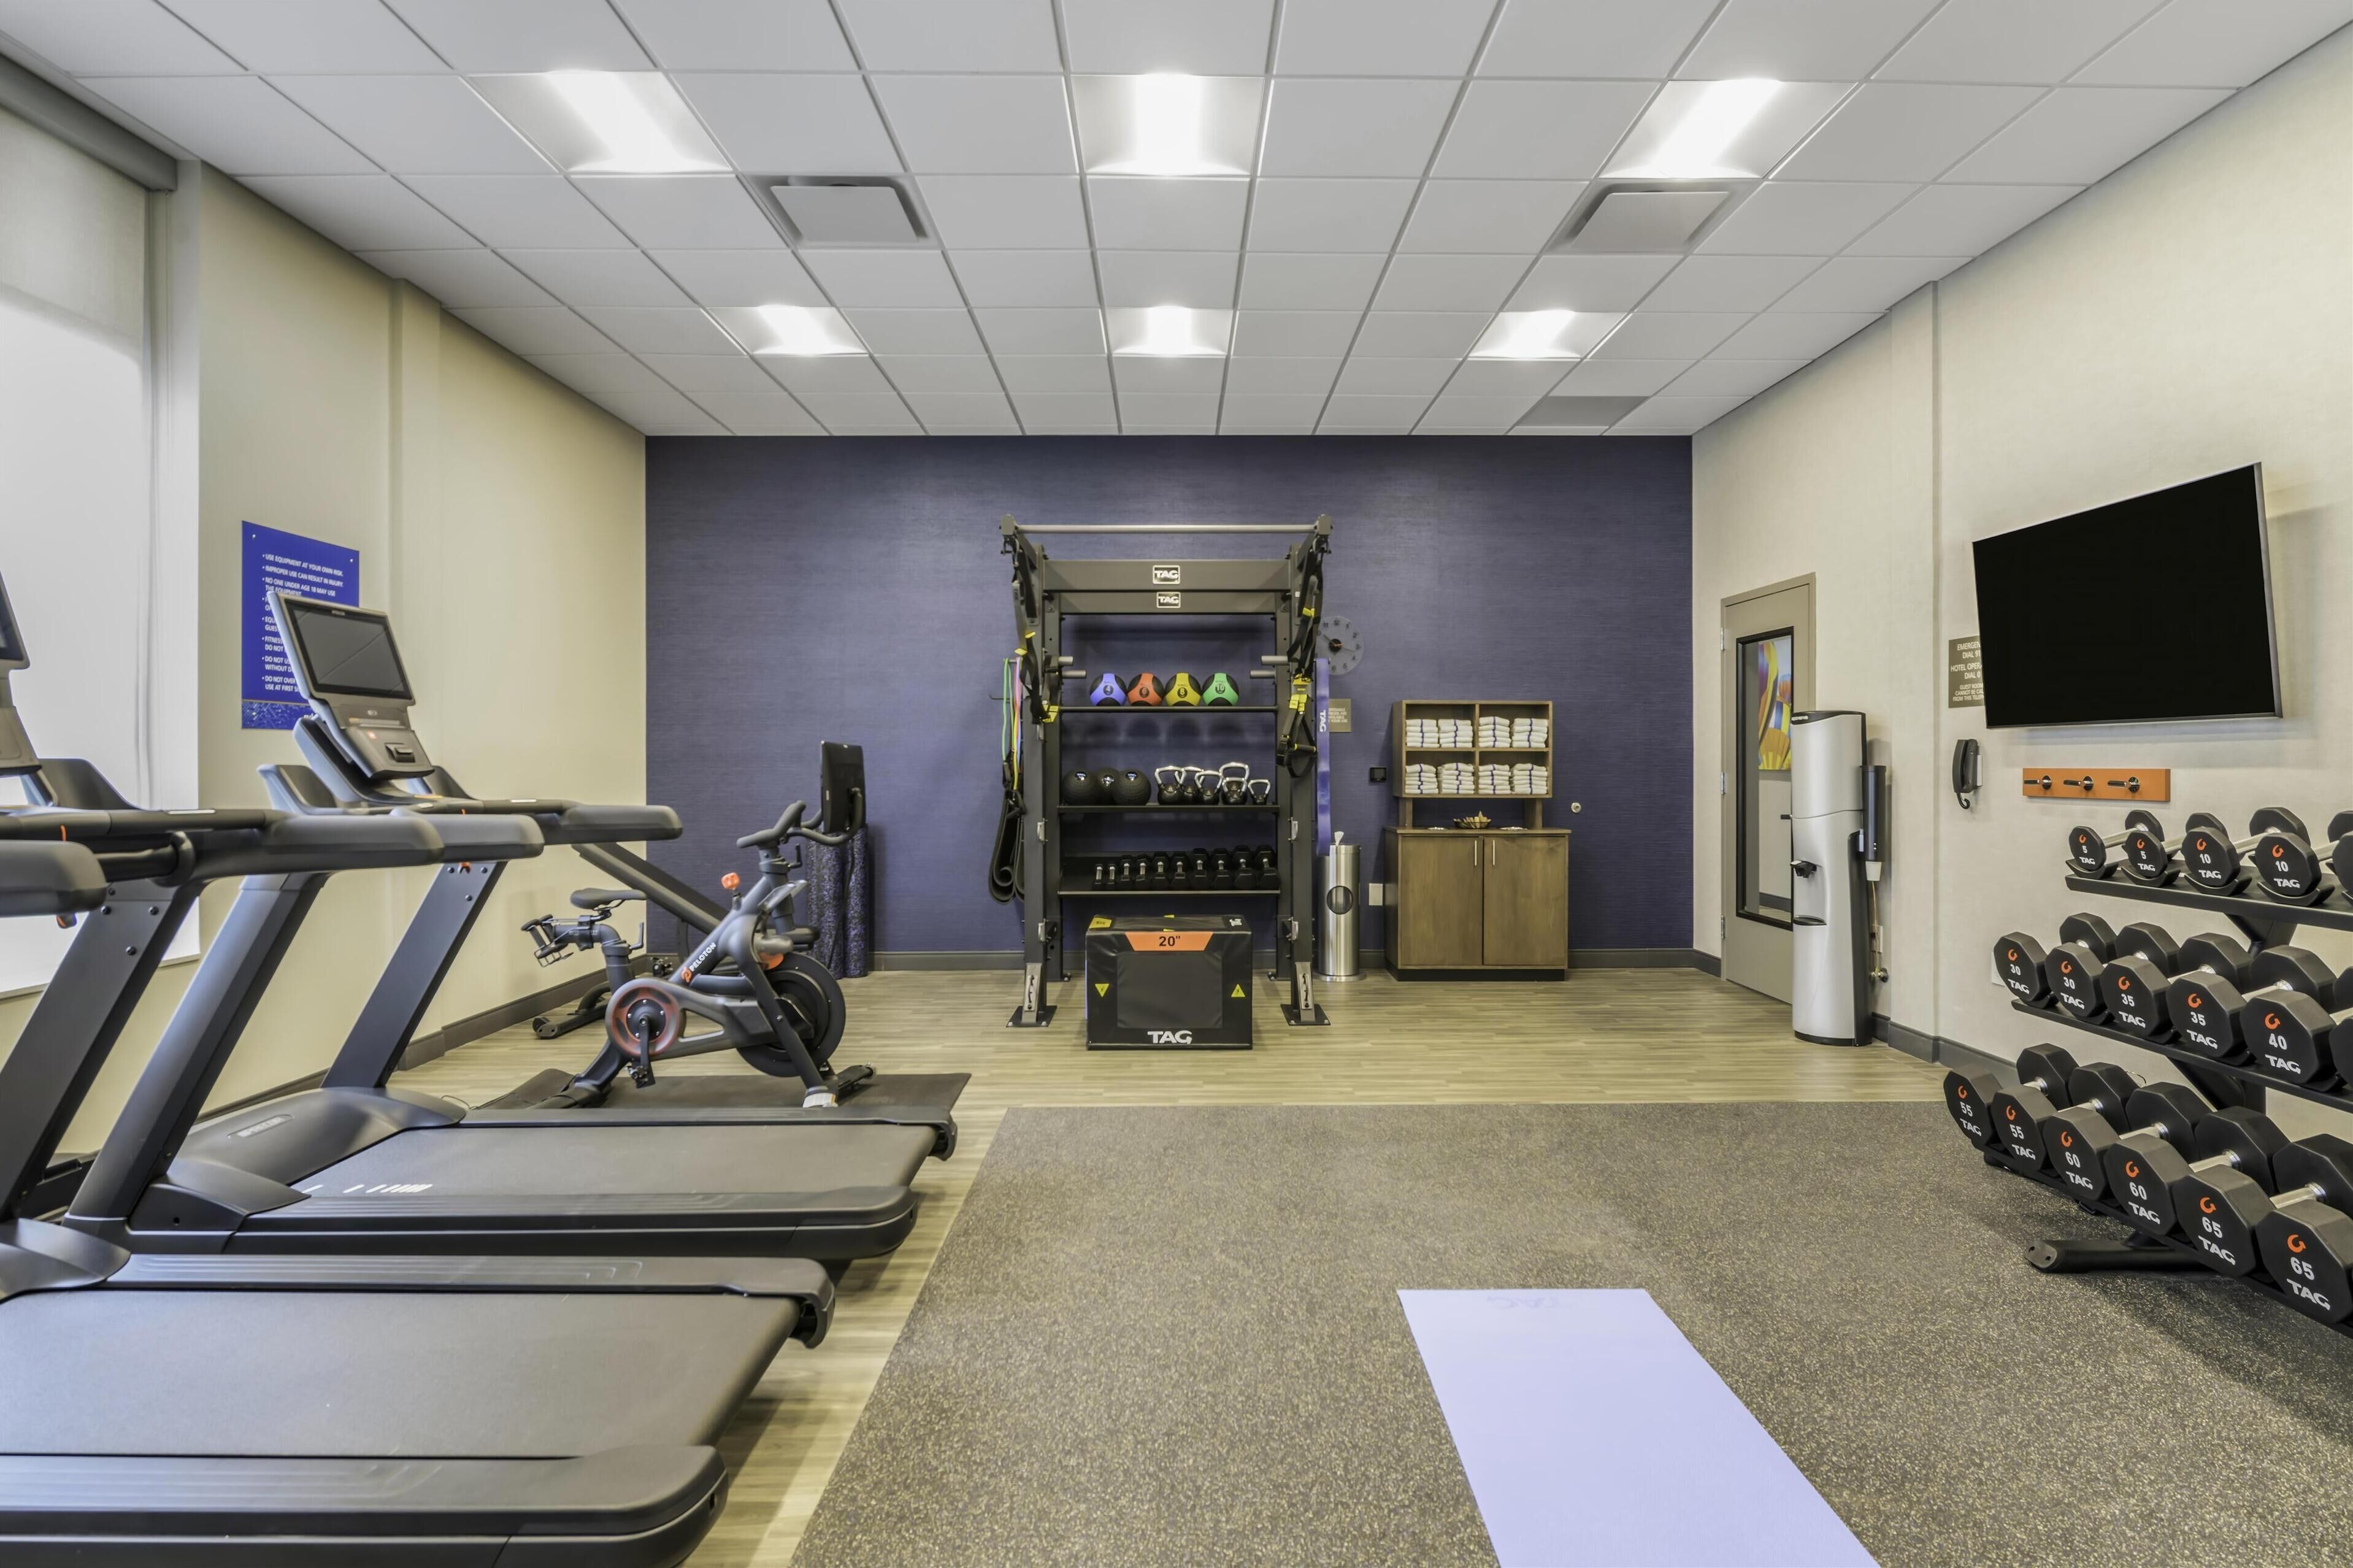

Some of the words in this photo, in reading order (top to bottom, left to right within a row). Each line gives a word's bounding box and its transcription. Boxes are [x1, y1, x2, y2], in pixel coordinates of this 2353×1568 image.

[275, 555, 302, 566] EQUIPMENT
[265, 565, 288, 575] IMPROPER
[308, 574, 323, 583] RESULT
[1154, 570, 1178, 579] TAG
[284, 580, 300, 590] UNDER
[1158, 596, 1179, 604] TAG
[1957, 641, 1981, 651] EMERGEN
[265, 664, 286, 672] WITHOUT
[1951, 664, 1965, 672] HOTEL
[2200, 853, 2211, 864] 10
[2276, 861, 2289, 872] 10
[2198, 870, 2221, 879] TAG
[2274, 878, 2300, 888] TAG
[1159, 936, 1180, 947] 20"
[689, 942, 716, 972] PELOTON
[2010, 964, 2021, 975] 30
[2008, 979, 2029, 994] TAG
[2063, 977, 2075, 990] 30
[2060, 993, 2084, 1010] TAG
[2122, 994, 2135, 1007] 35
[2119, 1011, 2145, 1028] TAG
[2190, 1012, 2206, 1026] 35
[1148, 1031, 1192, 1044] TAG
[2187, 1029, 2217, 1049] TAG
[2269, 1033, 2287, 1050] 40
[2265, 1055, 2301, 1074] TAG
[1960, 1101, 1973, 1116] 55
[1960, 1118, 1981, 1137] TAG
[2010, 1124, 2024, 1139] 55
[2012, 1145, 2035, 1159] TAG
[2065, 1152, 2081, 1167] 60
[2066, 1171, 2093, 1189] TAG
[2130, 1182, 2147, 1200] 60
[2128, 1202, 2160, 1224] TAG
[2202, 1216, 2222, 1238] 65
[2198, 1236, 2235, 1265] TAG
[2290, 1257, 2314, 1280] 65
[2287, 1278, 2330, 1310] TAG
